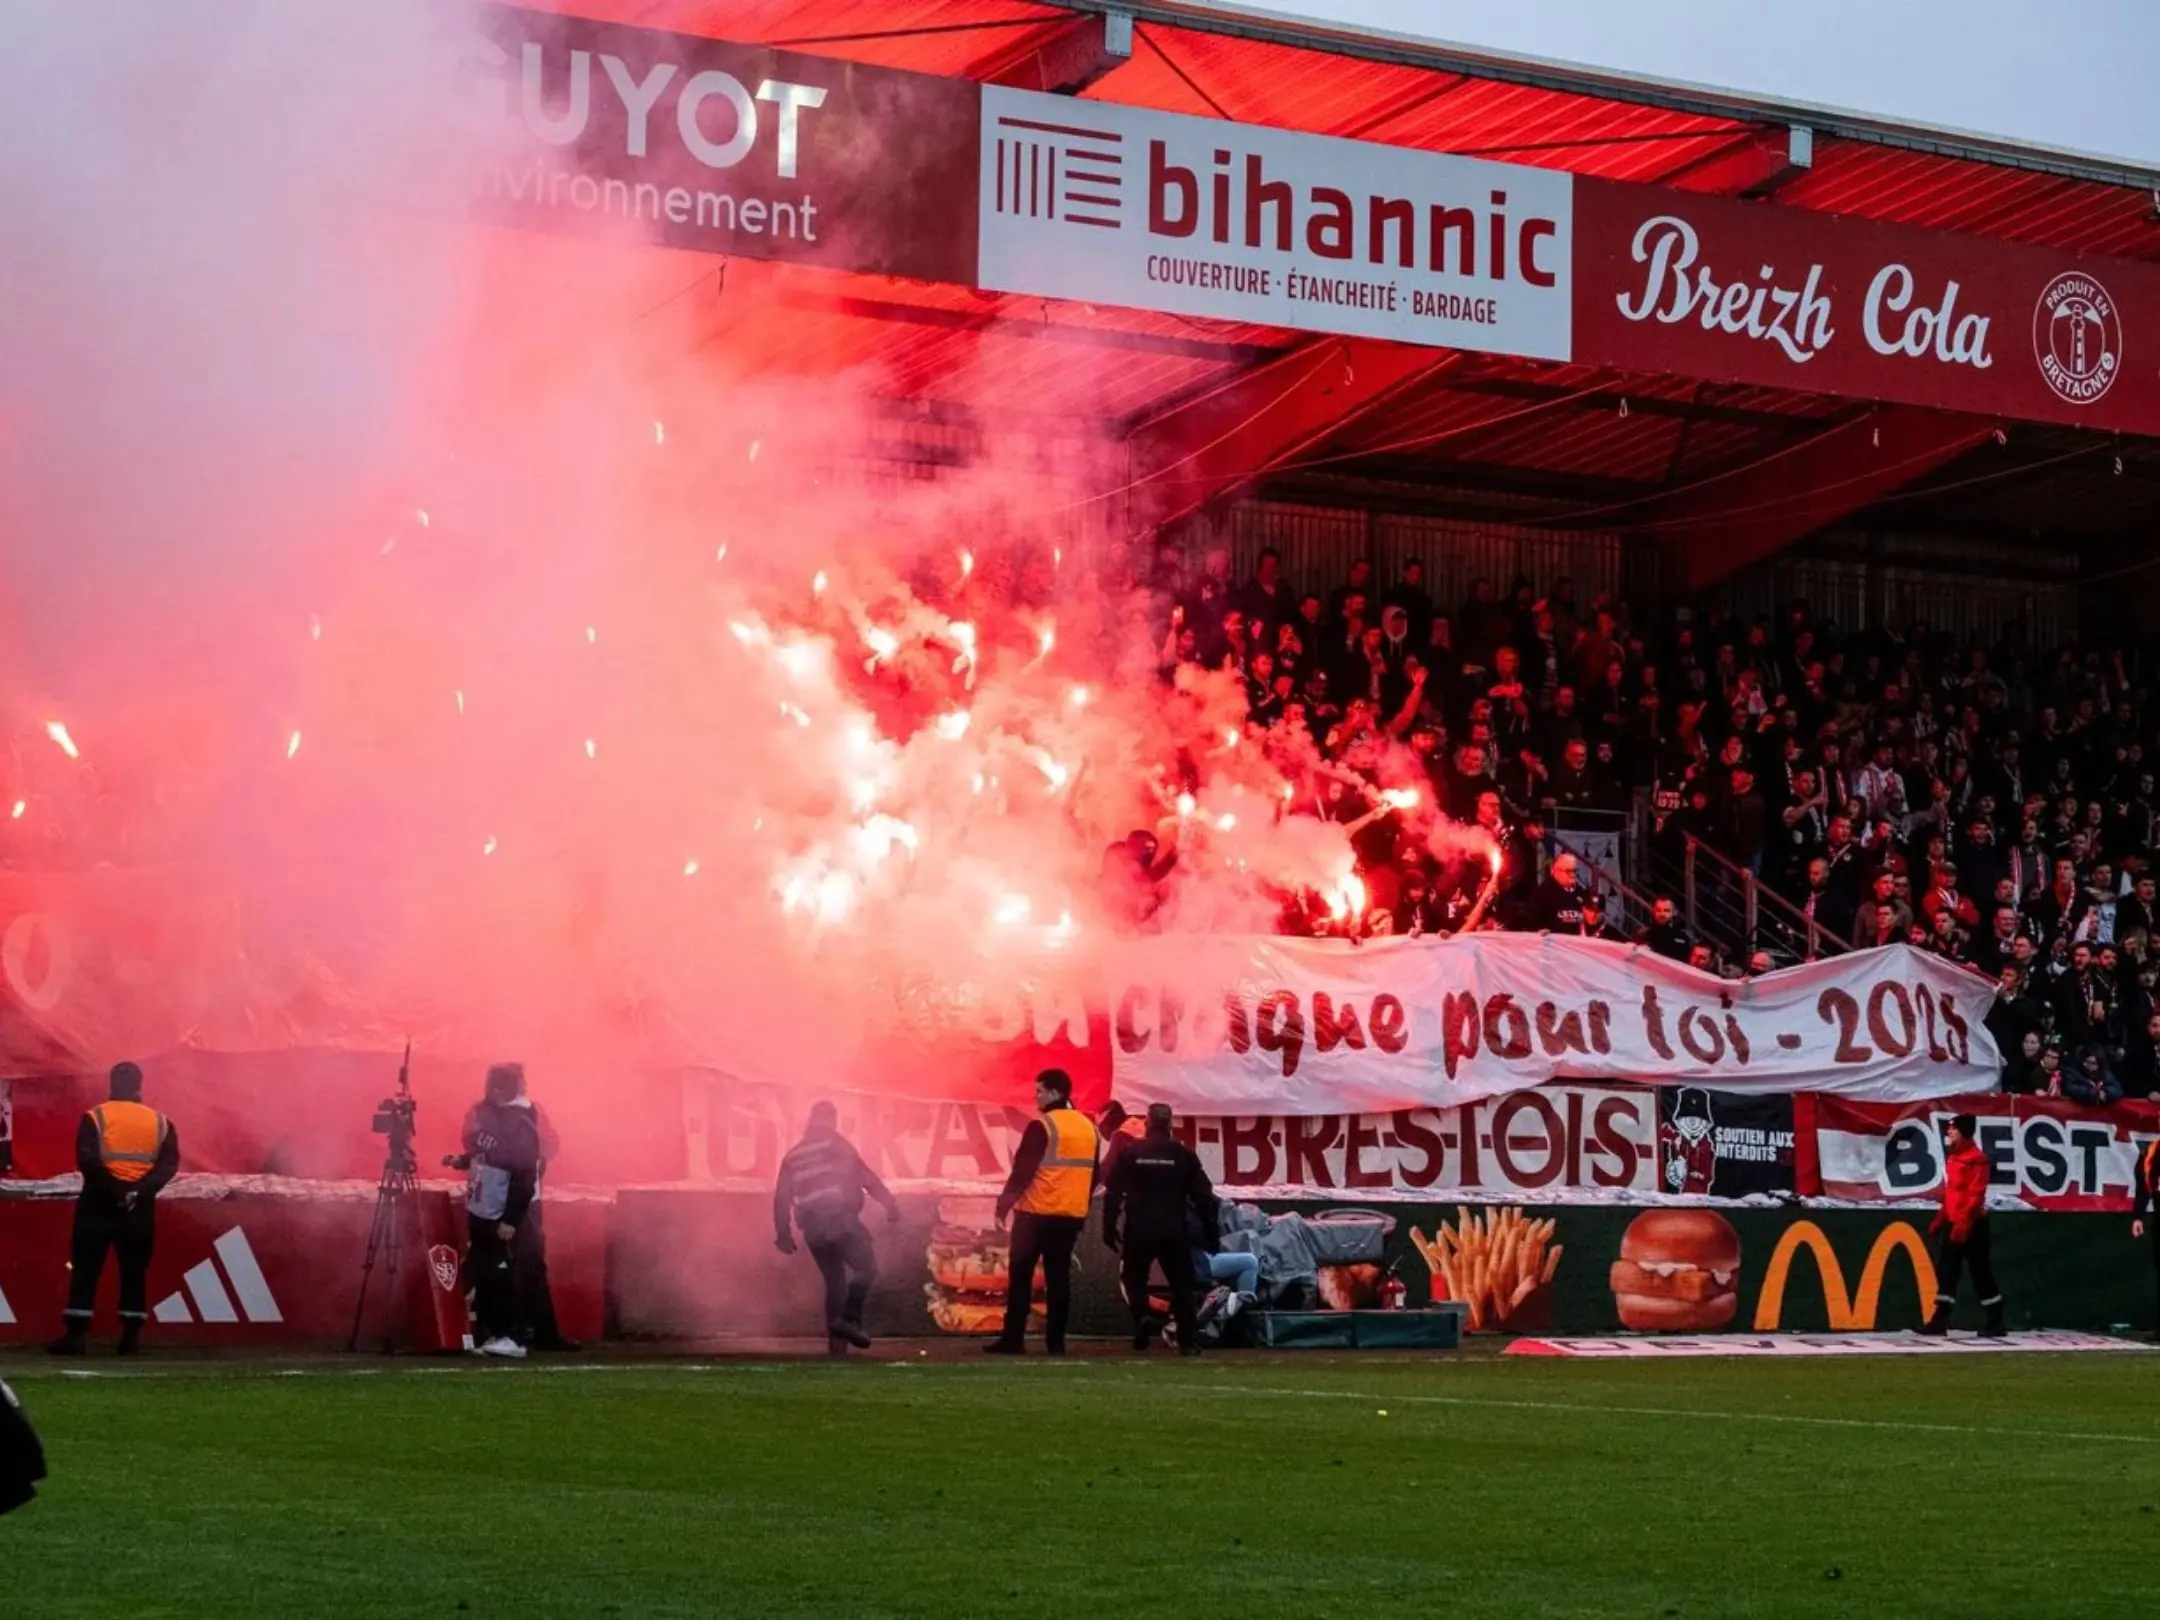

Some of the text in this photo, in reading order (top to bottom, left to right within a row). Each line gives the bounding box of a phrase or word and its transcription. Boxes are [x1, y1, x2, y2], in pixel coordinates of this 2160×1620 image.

[476, 155, 817, 242] nvironnement
[1147, 140, 1556, 288] bihannic
[1147, 254, 1270, 296] COUVERTURE
[1412, 296, 1497, 325] BARDAGE
[1616, 215, 1992, 369] Breizh Cola
[2045, 280, 2110, 317] PRODUIT EN
[2042, 353, 2109, 397] BRETAGNE
[1442, 991, 1612, 1080] pour
[1642, 985, 1750, 1066] toi
[1715, 1127, 1795, 1148] SOUTIEN AUX
[1715, 1143, 1777, 1162] INTERDITS
[1884, 1117, 2111, 1195] BEST
